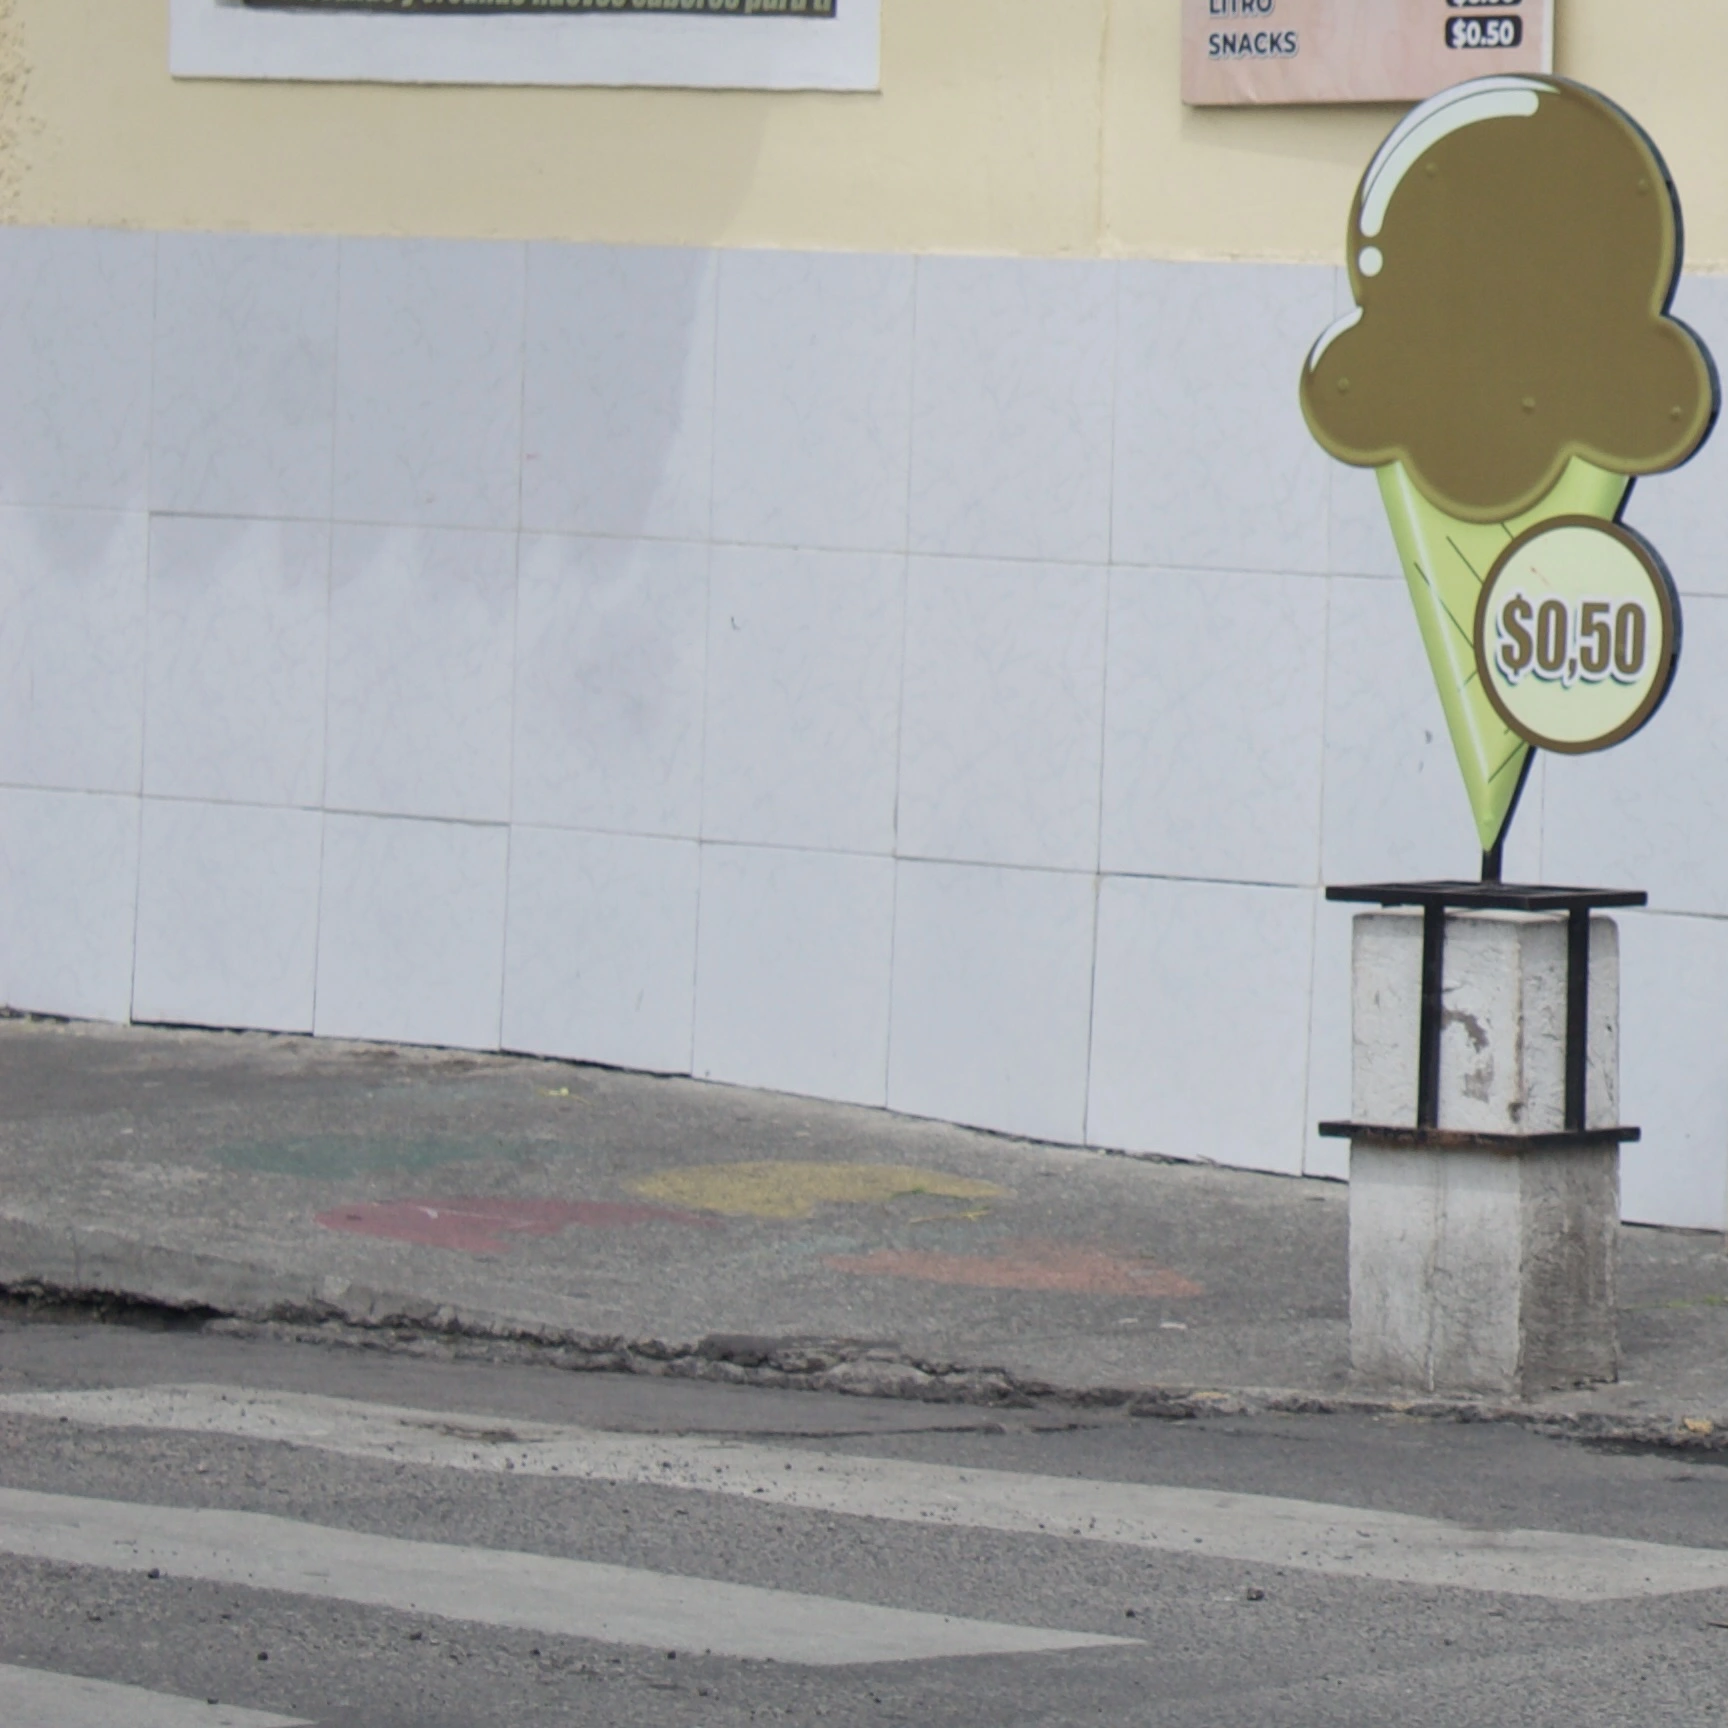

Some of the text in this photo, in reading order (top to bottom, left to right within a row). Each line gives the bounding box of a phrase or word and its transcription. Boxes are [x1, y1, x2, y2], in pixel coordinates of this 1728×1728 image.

[1209, 31, 1297, 55] SNACKS
[1452, 18, 1515, 48] $0.50
[1501, 593, 1646, 680] $0,50
